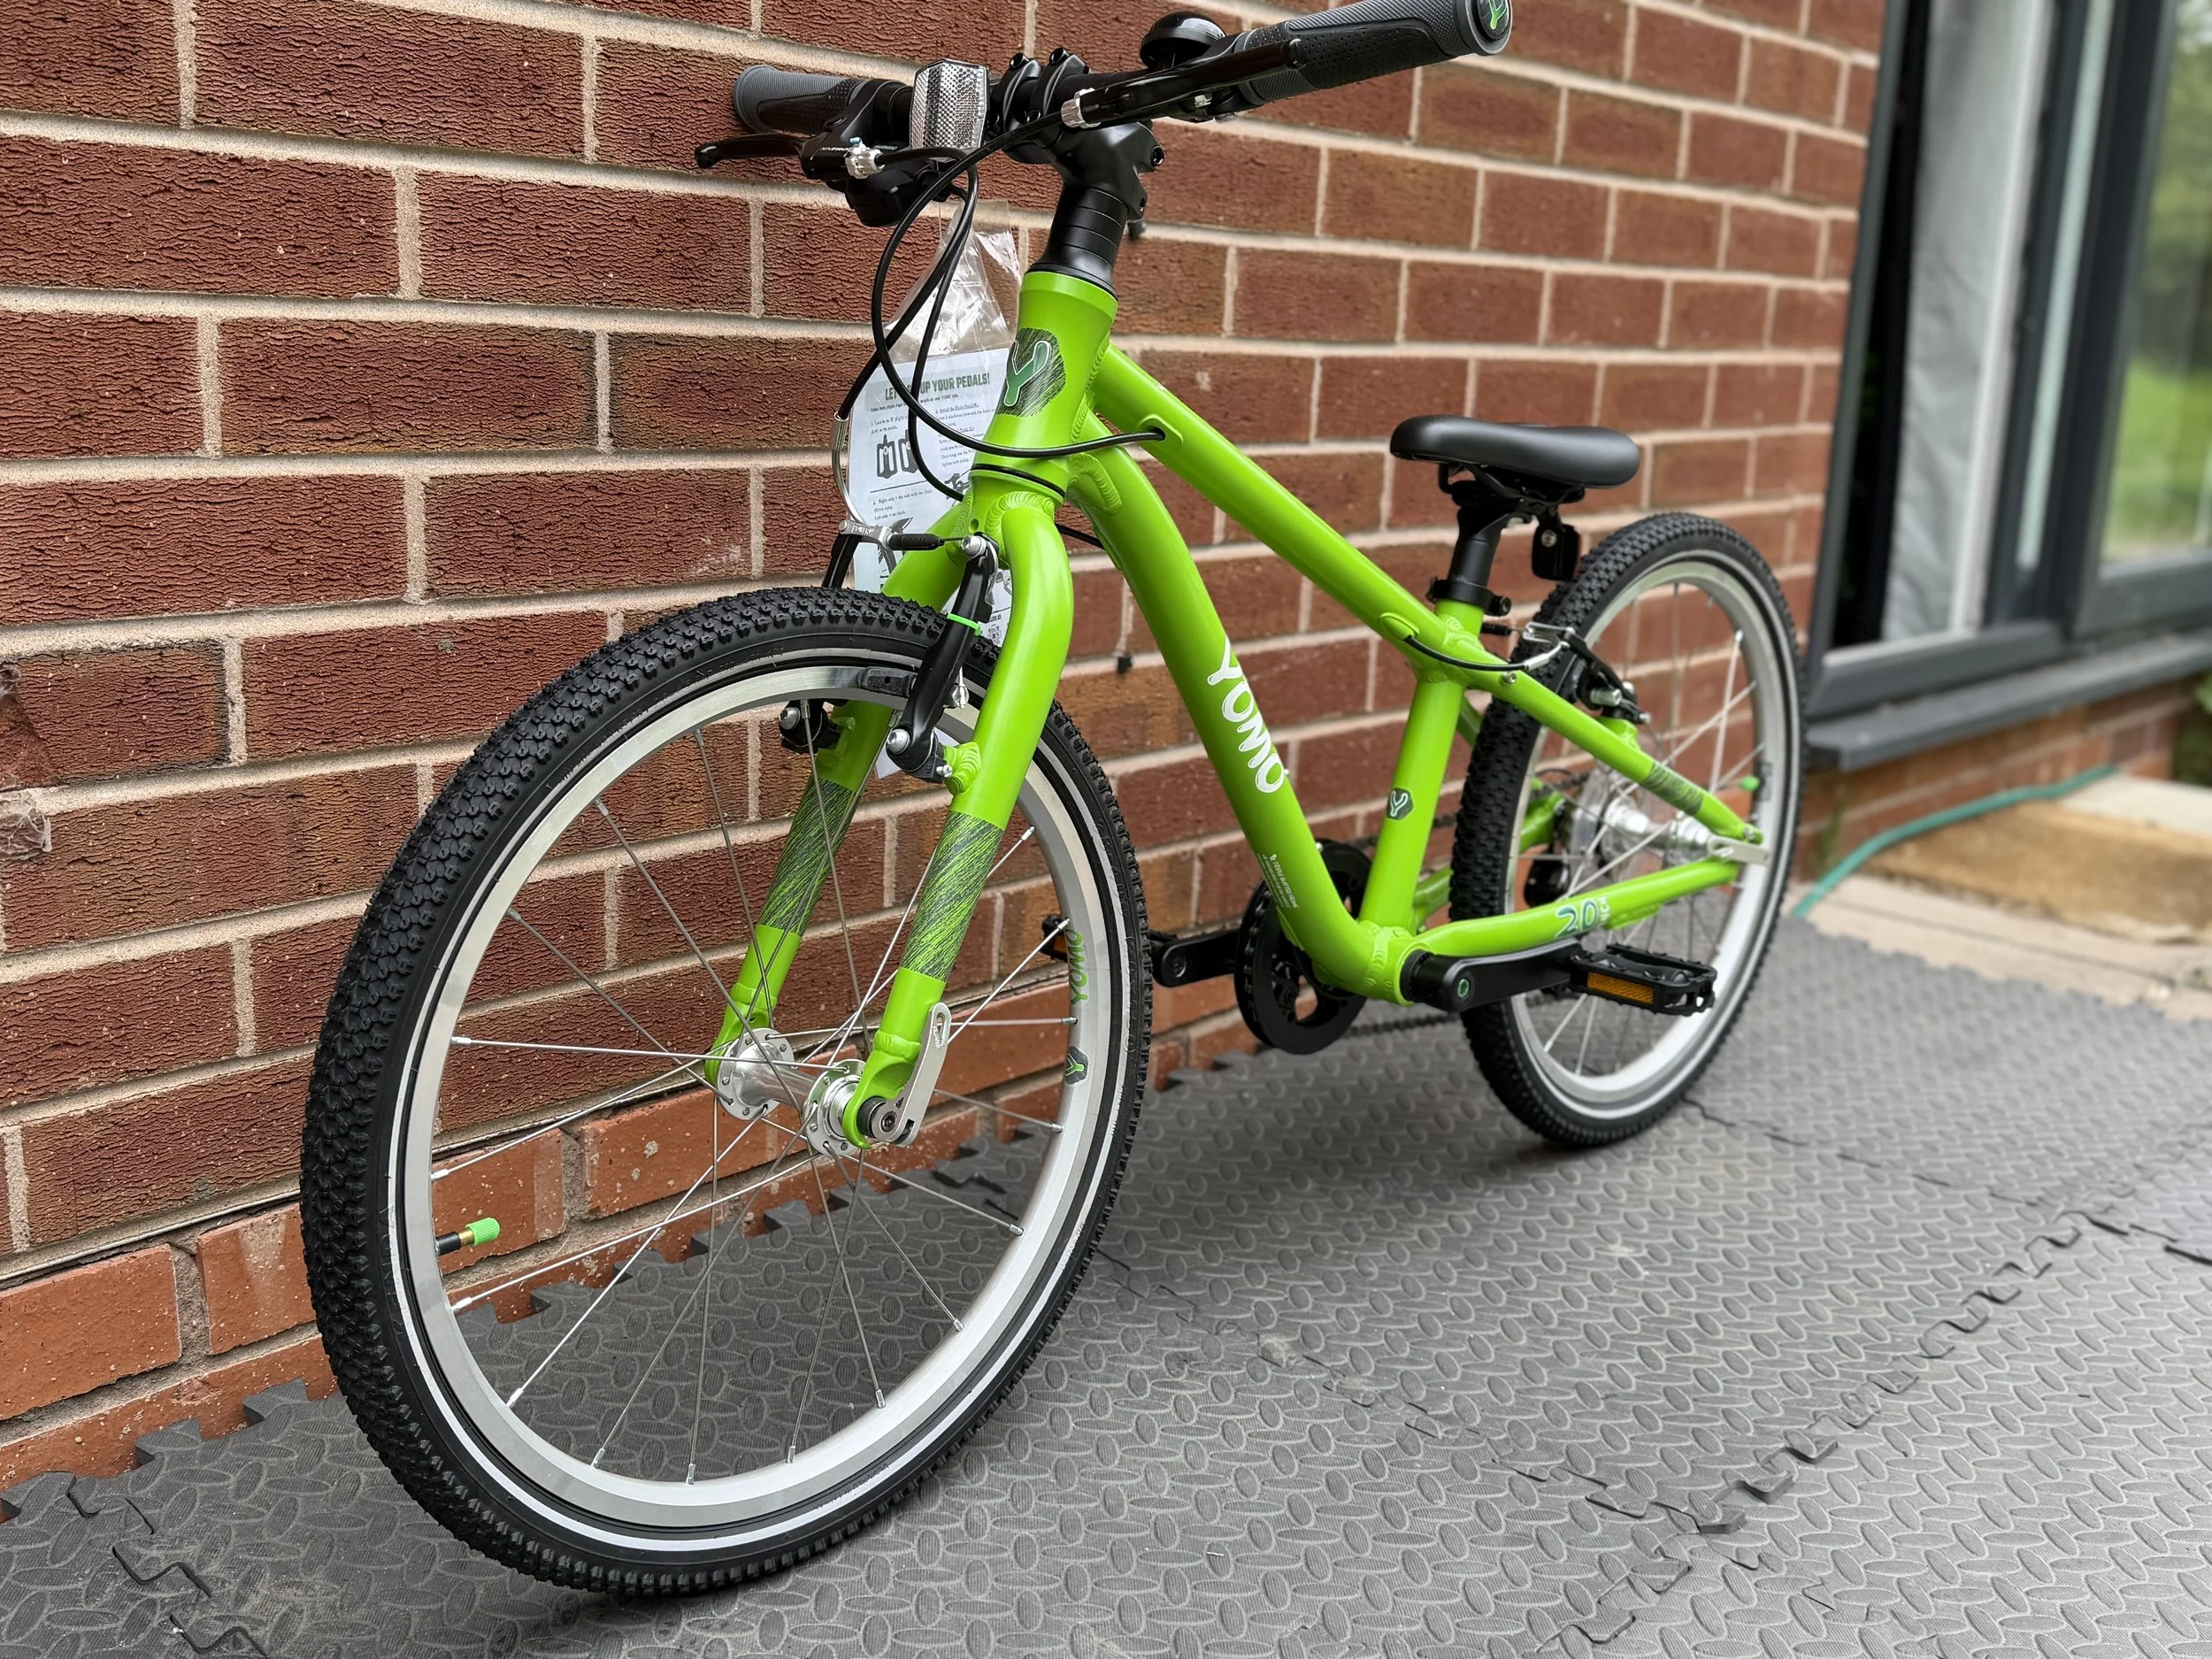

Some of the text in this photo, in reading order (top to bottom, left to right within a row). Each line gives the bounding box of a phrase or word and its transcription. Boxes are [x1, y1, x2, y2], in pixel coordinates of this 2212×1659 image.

[932, 377, 955, 391] YOUR
[956, 373, 991, 389] PEDALS!
[1207, 636, 1286, 793] YOMO
[1555, 898, 1600, 939] 20
[1066, 928, 1089, 1006] YOMO
